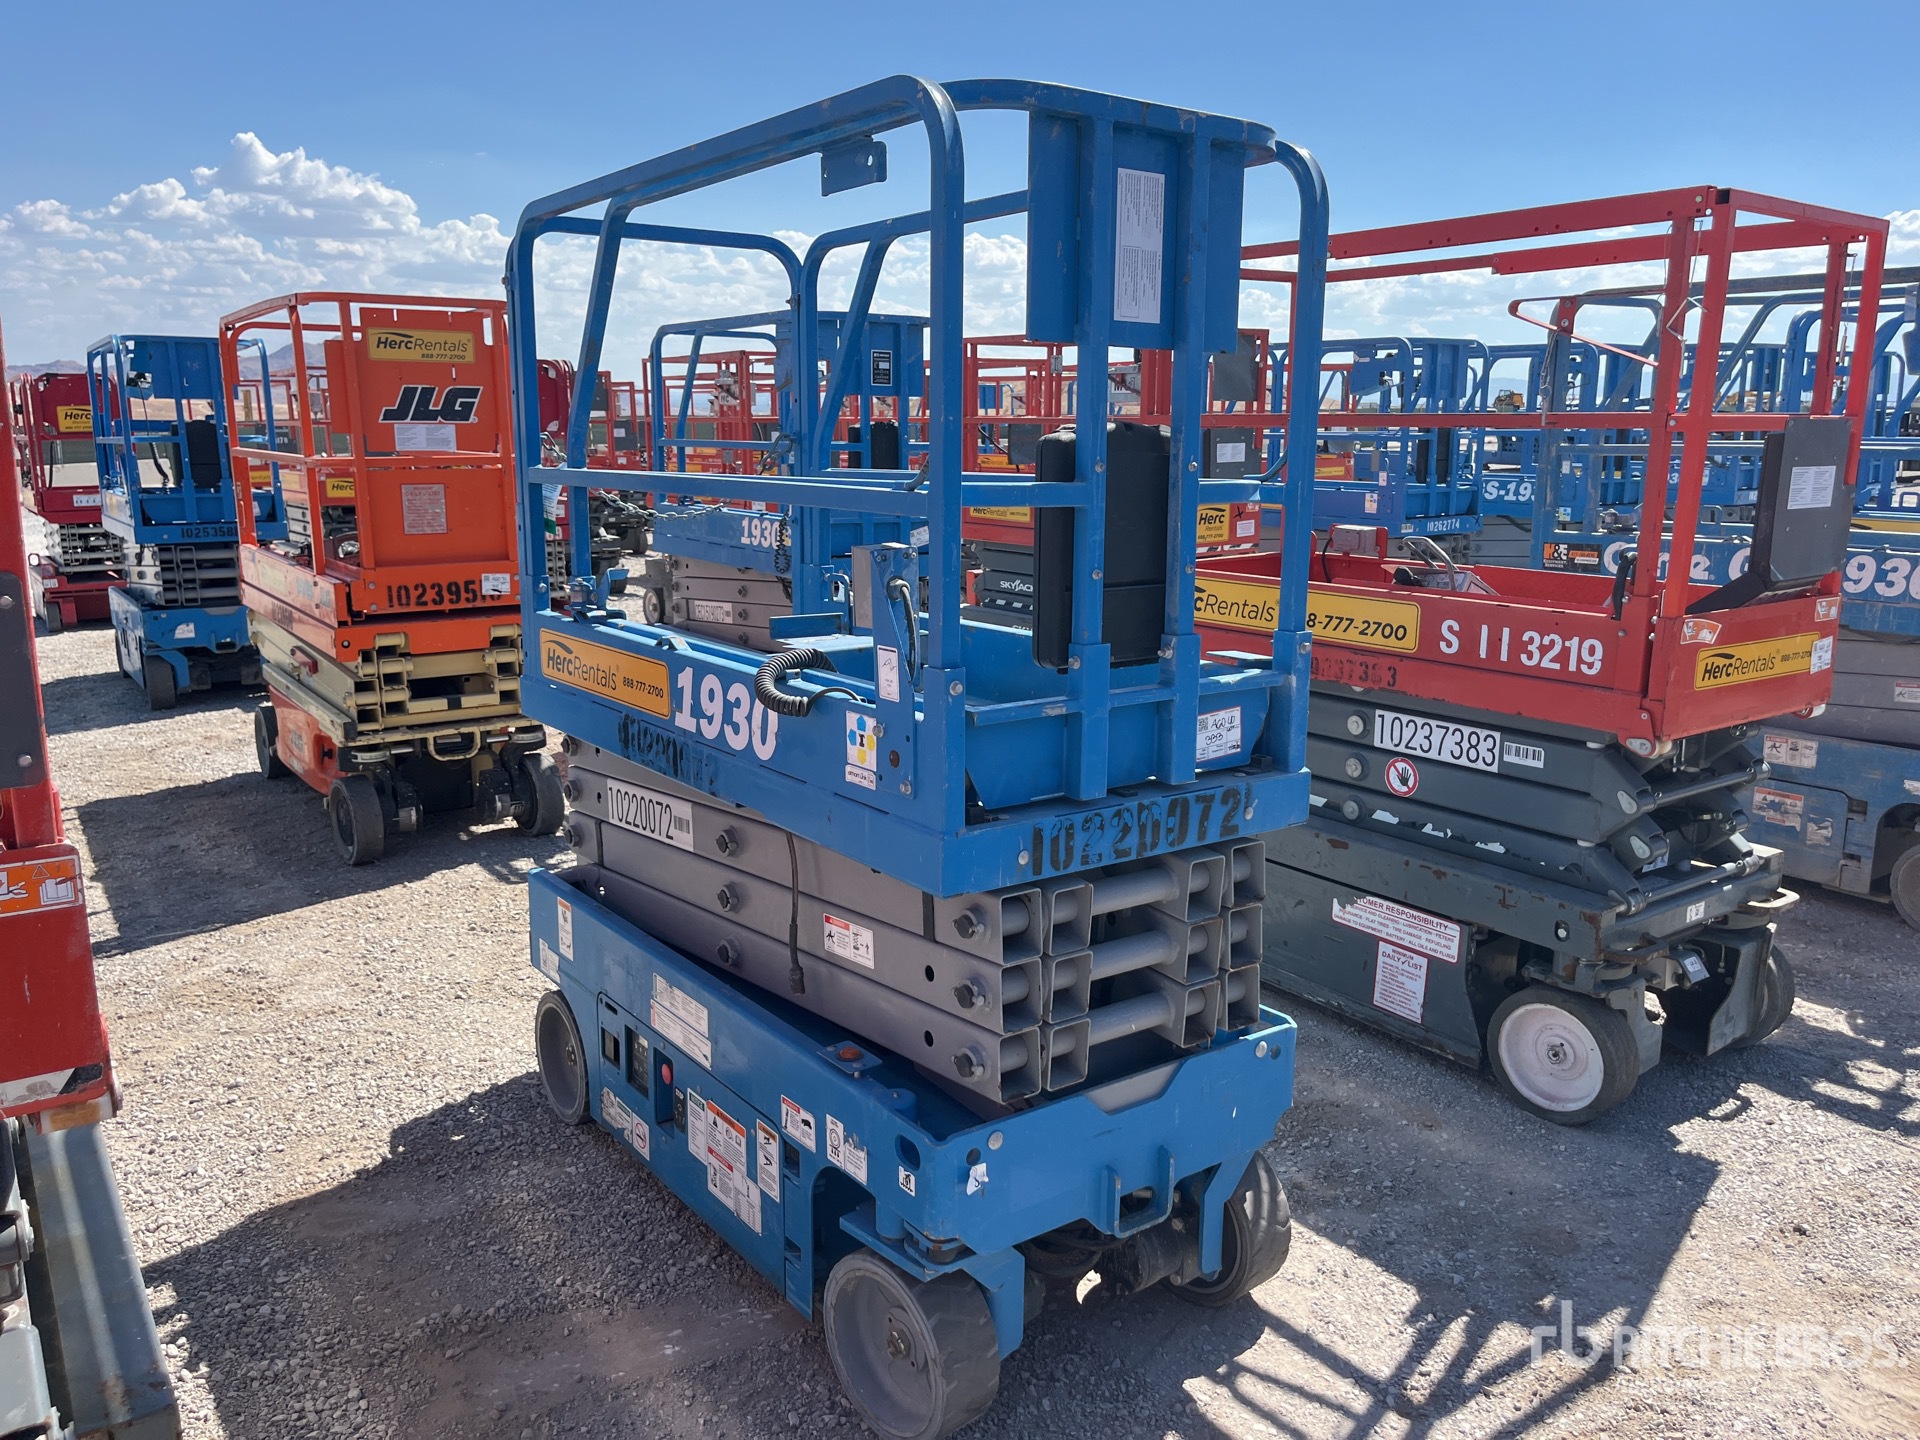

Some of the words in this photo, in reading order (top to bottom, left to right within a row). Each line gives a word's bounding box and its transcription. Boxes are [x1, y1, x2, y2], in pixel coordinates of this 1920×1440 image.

[376, 336, 468, 352] HercRentals
[421, 353, 466, 361] 888-777-2700
[379, 385, 483, 423] JLG
[1199, 513, 1225, 525] Herc
[1427, 518, 1460, 531] 10262774
[387, 579, 502, 608] 102395
[1520, 631, 1603, 675] 3219
[1702, 653, 1776, 681] HercRentals
[547, 648, 617, 692] HercRentals
[623, 677, 664, 699] 888-777-2700
[674, 666, 779, 760] 1930
[1377, 714, 1497, 767] 10237383
[609, 787, 674, 840] 10220072
[1385, 904, 1448, 931] RESPONSIBILITY
[1381, 950, 1400, 963] DAILY
[1407, 960, 1422, 971] LIST
